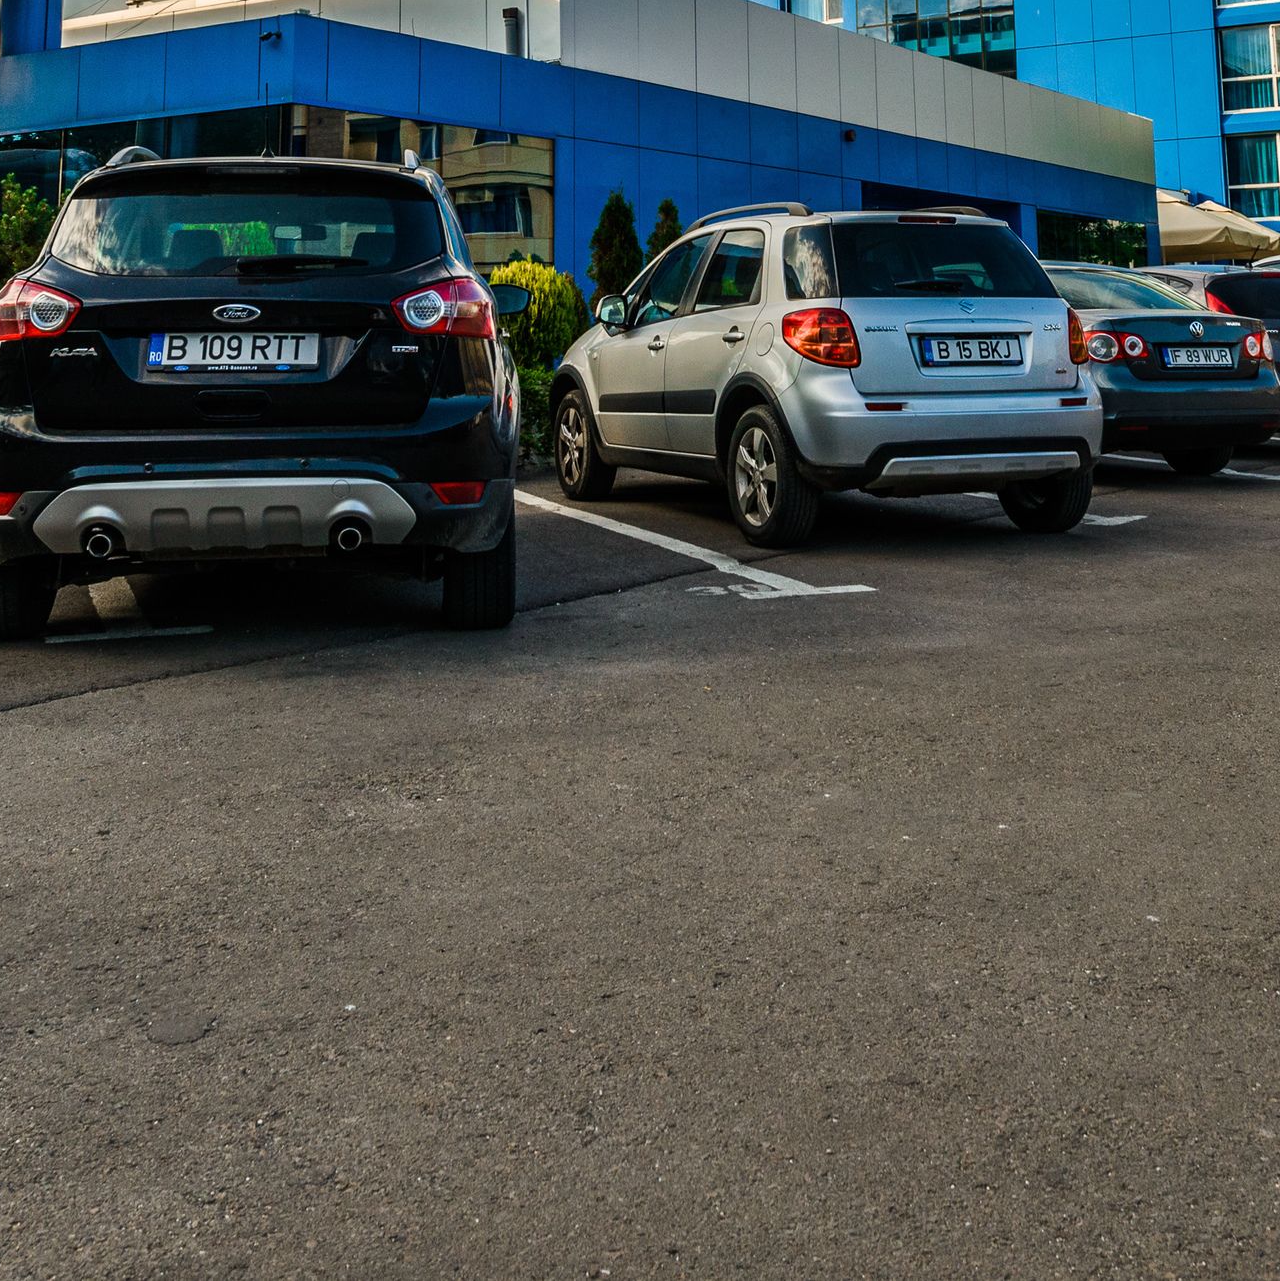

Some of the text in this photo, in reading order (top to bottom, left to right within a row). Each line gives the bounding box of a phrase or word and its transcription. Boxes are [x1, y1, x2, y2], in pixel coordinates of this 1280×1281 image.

[167, 334, 306, 361] B 109 RTT
[937, 340, 1011, 360] B 15 BKJ
[1186, 349, 1200, 363] 89
[1201, 349, 1229, 363] WUR
[149, 351, 162, 362] RO
